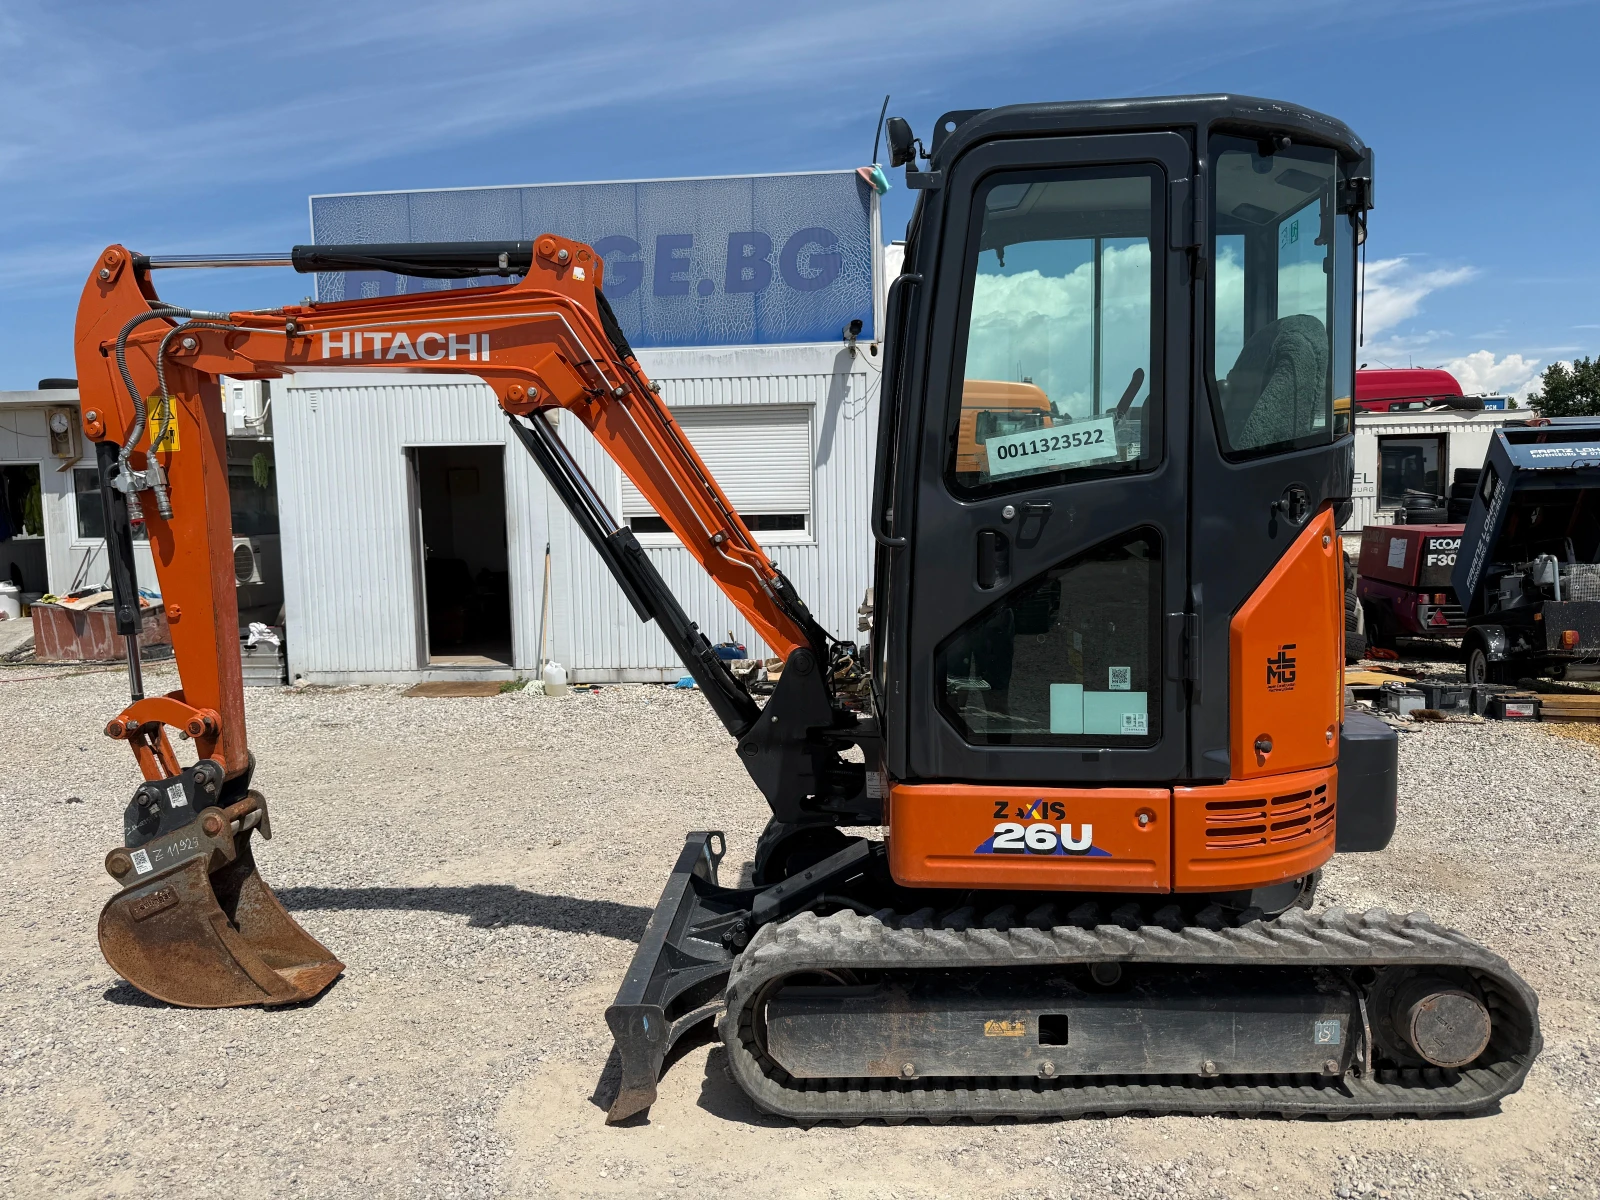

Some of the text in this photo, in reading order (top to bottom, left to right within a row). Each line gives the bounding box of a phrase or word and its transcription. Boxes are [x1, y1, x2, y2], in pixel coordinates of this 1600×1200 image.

[322, 331, 490, 361] HITACHI
[997, 428, 1105, 460] 0011323522
[993, 822, 1092, 855] 26U
